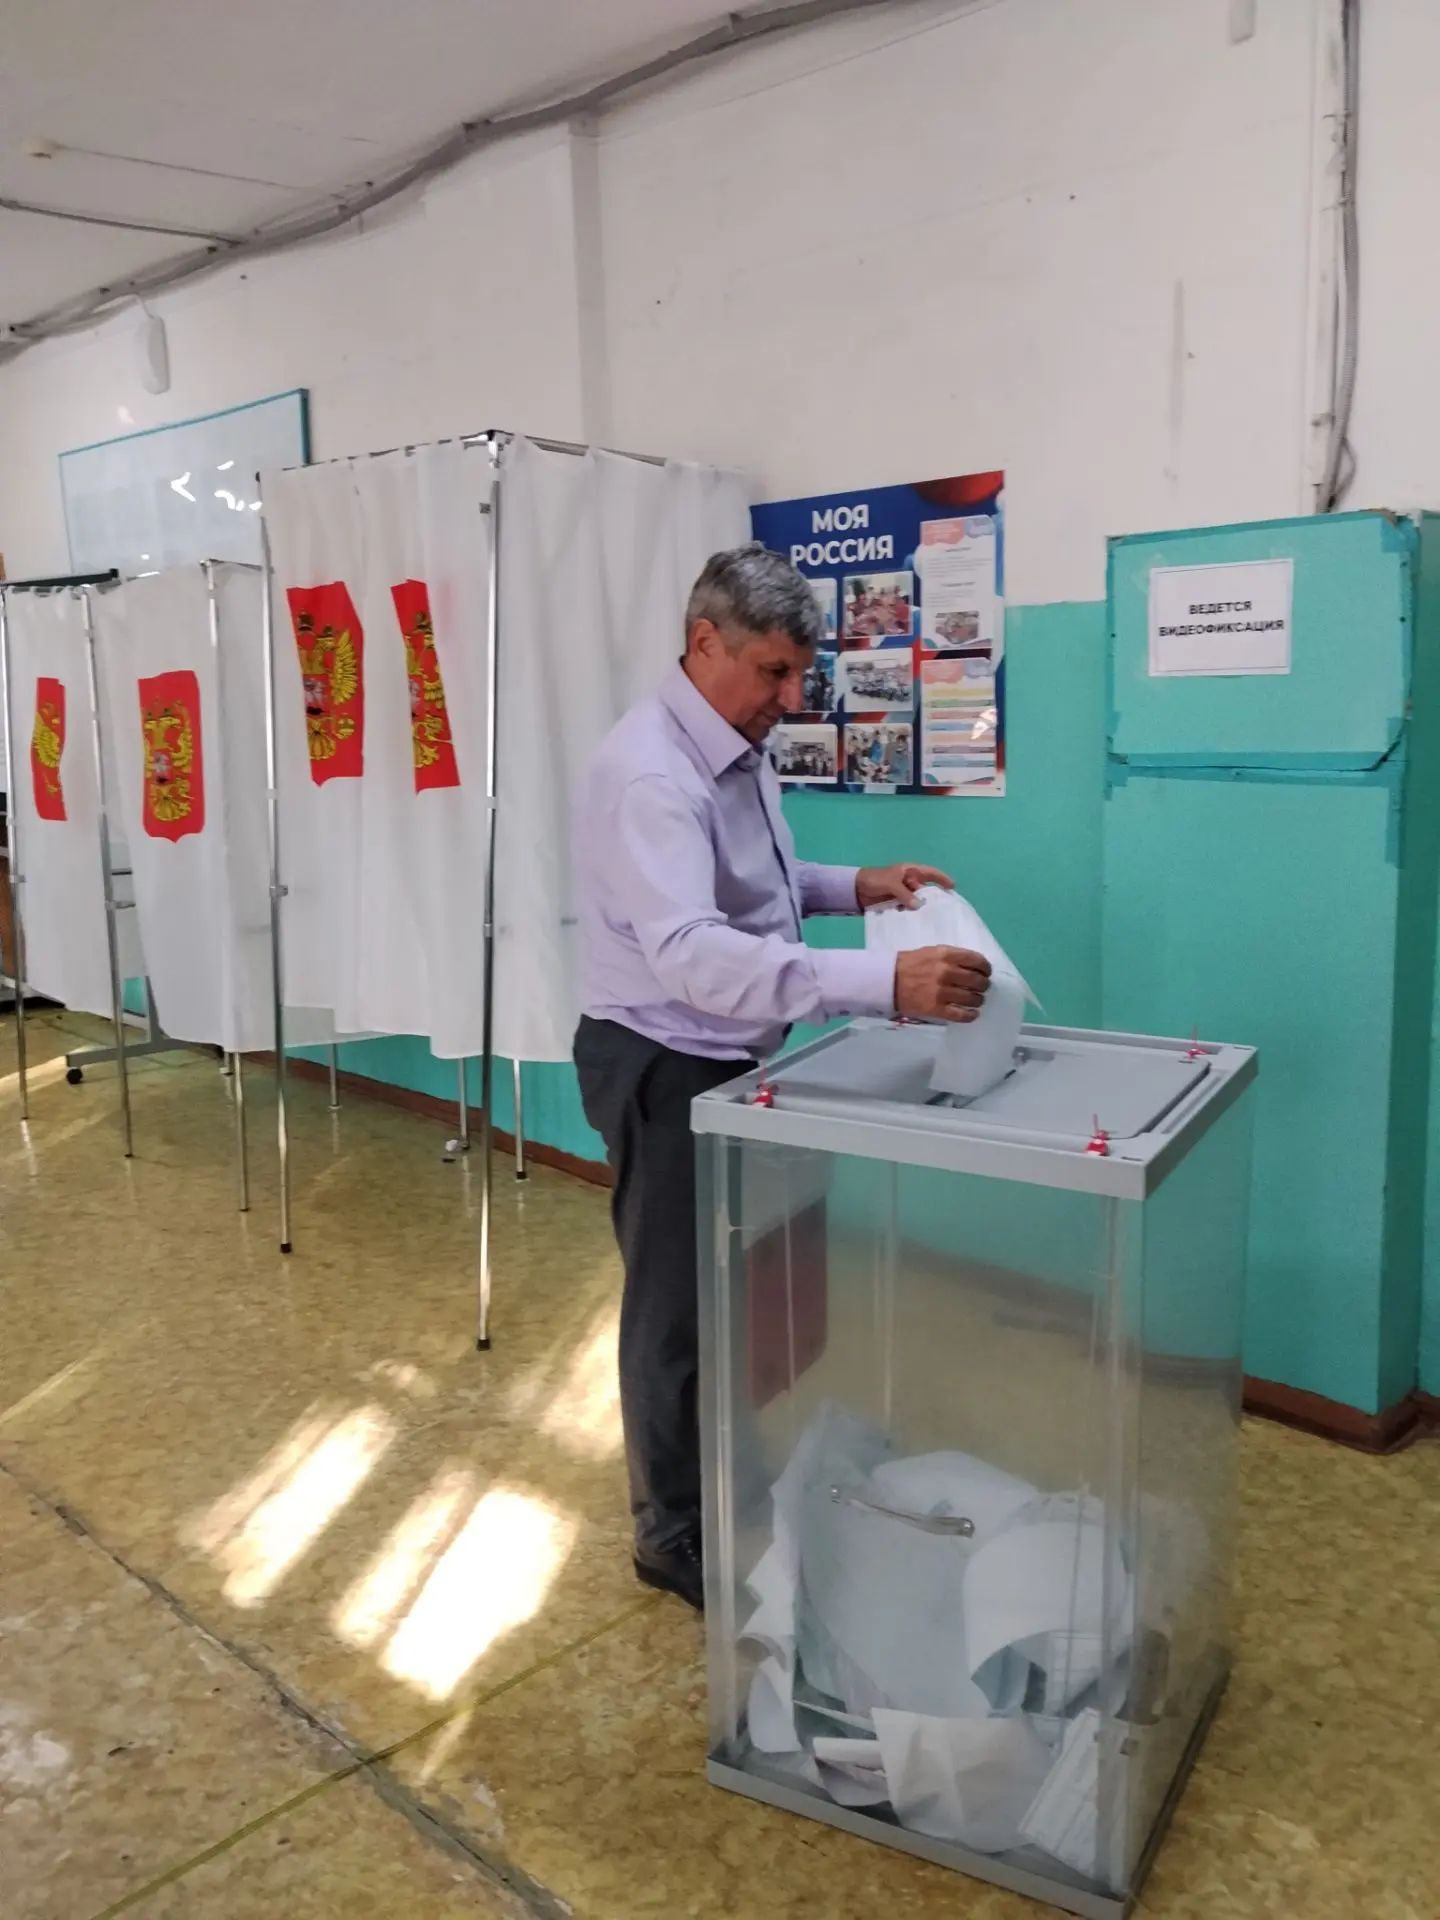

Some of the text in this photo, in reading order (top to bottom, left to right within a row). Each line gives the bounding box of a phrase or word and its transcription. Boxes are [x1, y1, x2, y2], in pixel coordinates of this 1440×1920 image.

[812, 504, 868, 533] МОЯ
[790, 534, 893, 567] РОССИЯ
[1189, 601, 1251, 614] ВЕДЕТСЯ
[1159, 620, 1284, 636] ВИДЕОФИКСАЦИЯ
